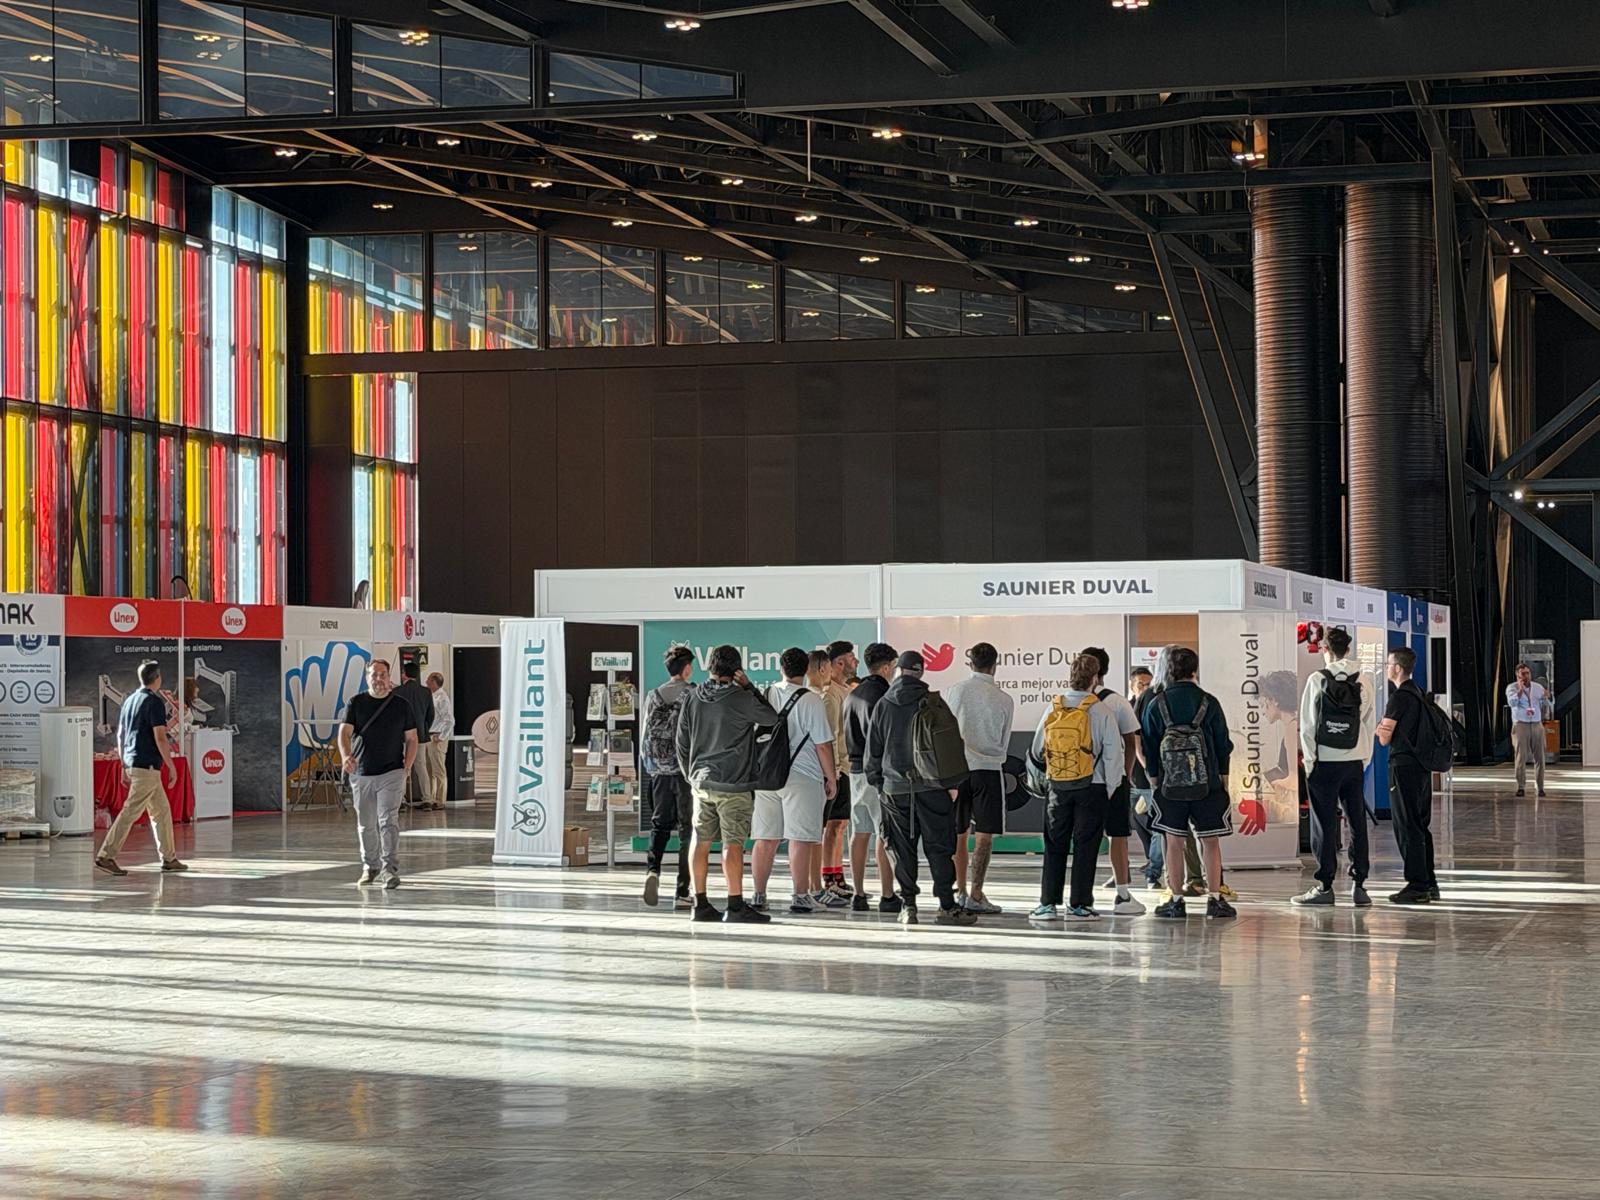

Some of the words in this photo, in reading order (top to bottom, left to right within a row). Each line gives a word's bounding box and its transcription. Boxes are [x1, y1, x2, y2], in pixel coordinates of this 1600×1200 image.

[674, 586, 746, 600] VAILLANT
[982, 580, 1076, 597] SAUNIER
[1083, 579, 1153, 594] DUVAL
[113, 611, 136, 624] Unex
[225, 616, 244, 628] Unex
[414, 619, 425, 637] LG
[124, 645, 149, 653] sistema
[151, 645, 161, 653] de
[161, 645, 190, 654] sopoes
[192, 644, 222, 652] aislantes
[602, 656, 630, 667] Vaillant
[964, 648, 1044, 666] Sunier
[1241, 633, 1259, 695] Duval
[1021, 678, 1053, 691] mejor
[1020, 693, 1039, 705] por
[519, 639, 545, 793] Vaillant
[1242, 702, 1260, 789] Saunier
[205, 757, 223, 769] Unex
